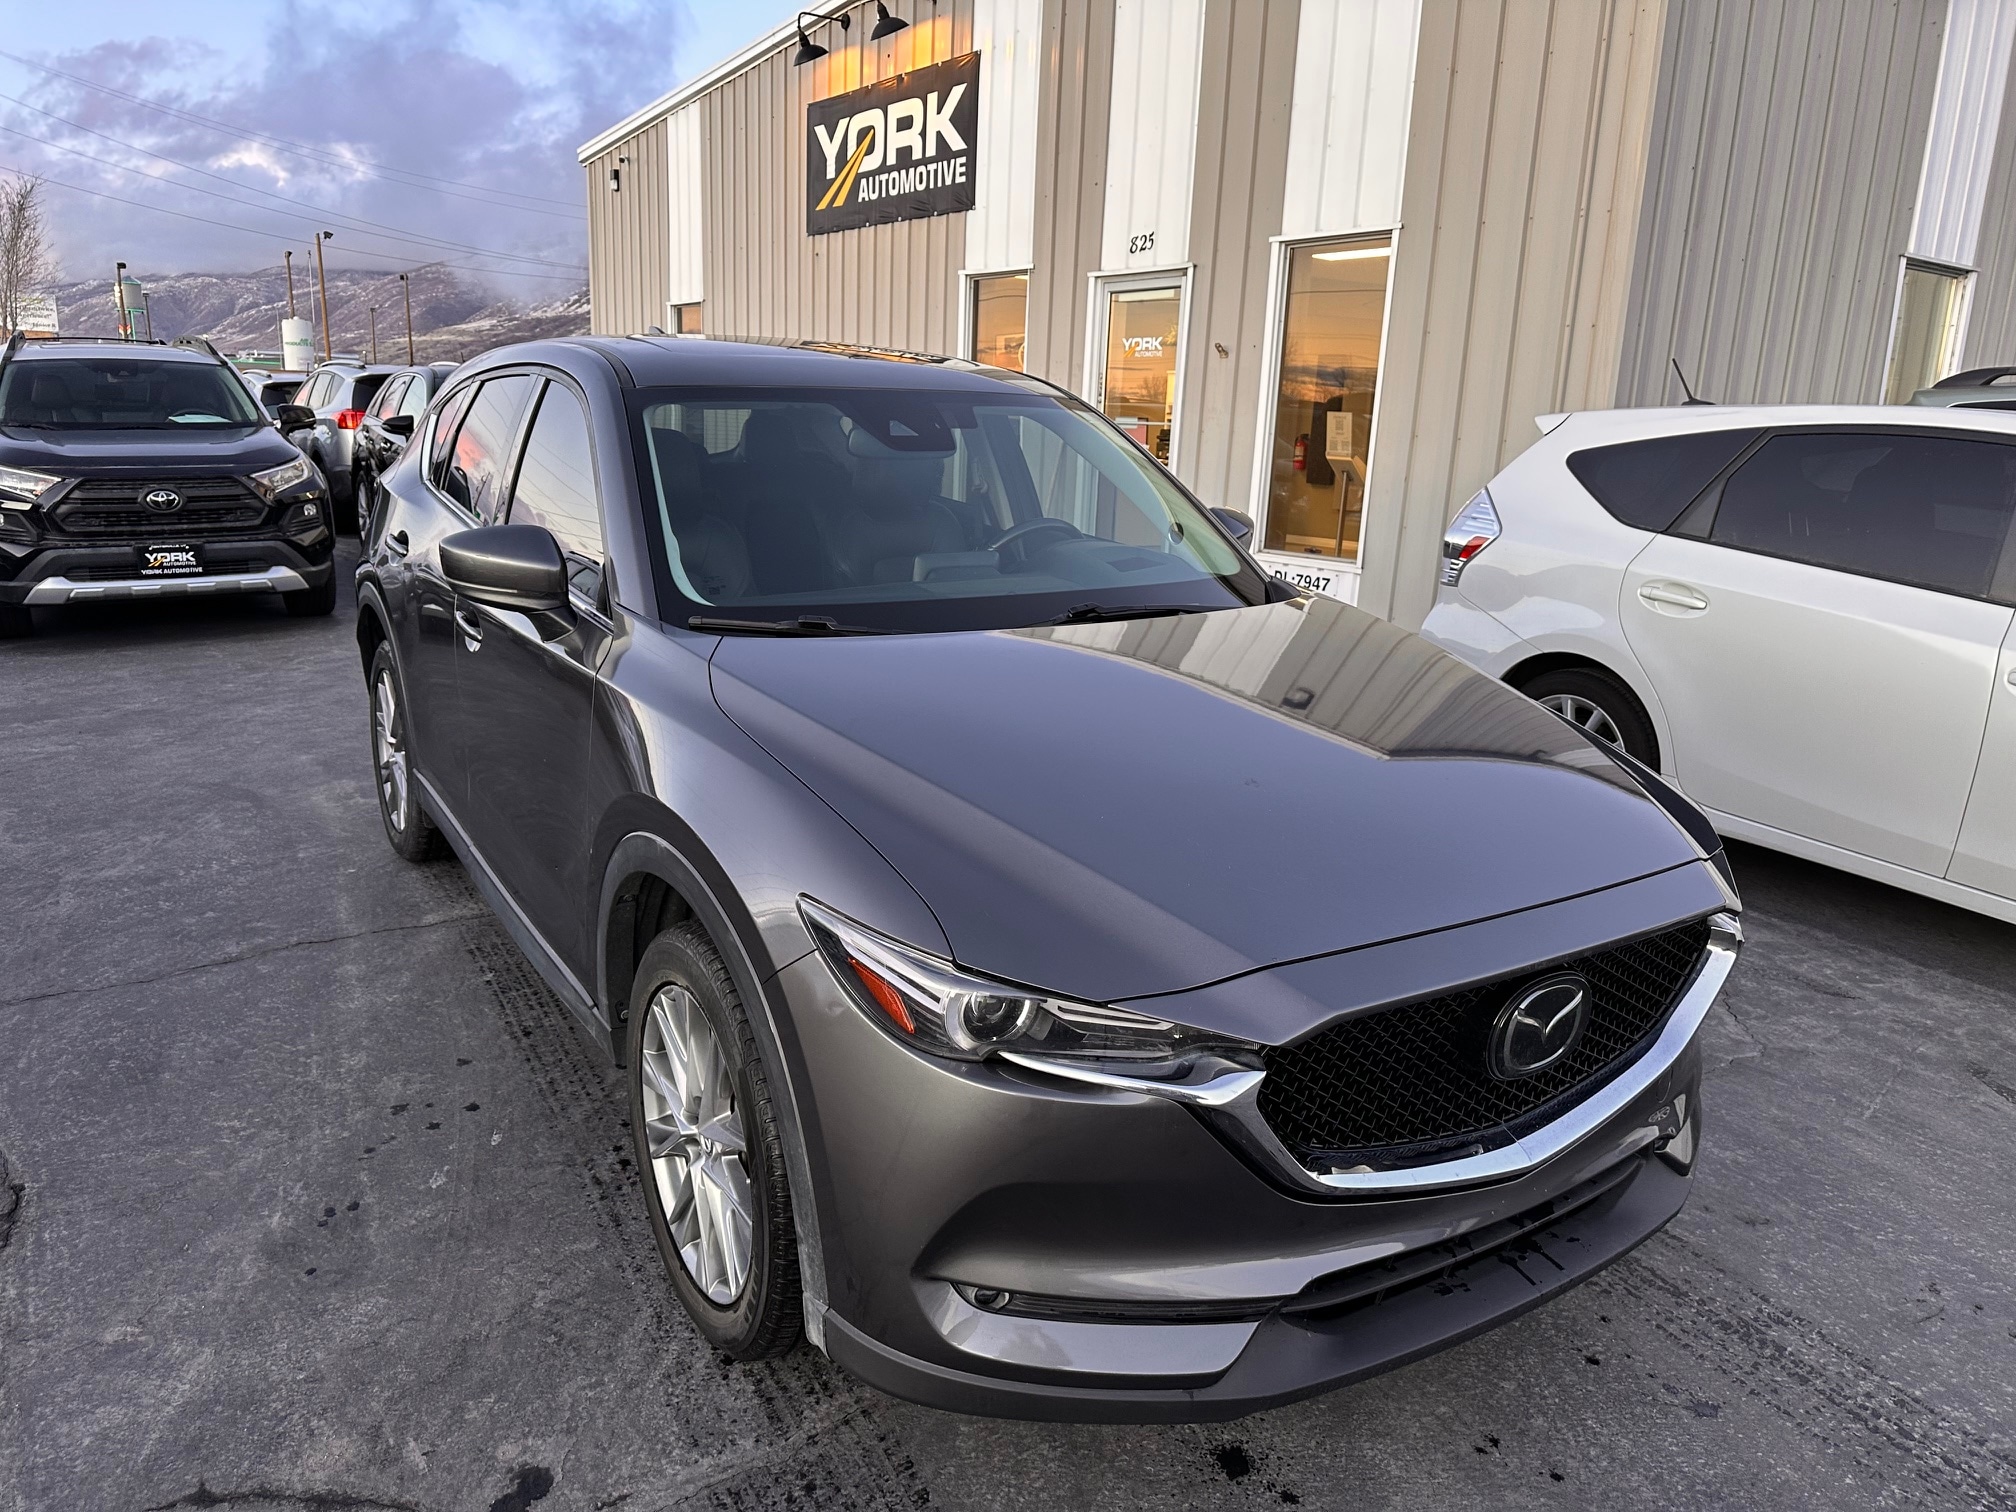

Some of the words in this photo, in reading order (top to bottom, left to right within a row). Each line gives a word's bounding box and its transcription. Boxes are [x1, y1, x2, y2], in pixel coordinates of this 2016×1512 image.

[813, 83, 968, 180] YORK
[858, 156, 967, 202] AUTOMOTIVE
[1129, 231, 1155, 254] 825
[1122, 336, 1163, 351] YORK
[144, 551, 196, 562] YORK
